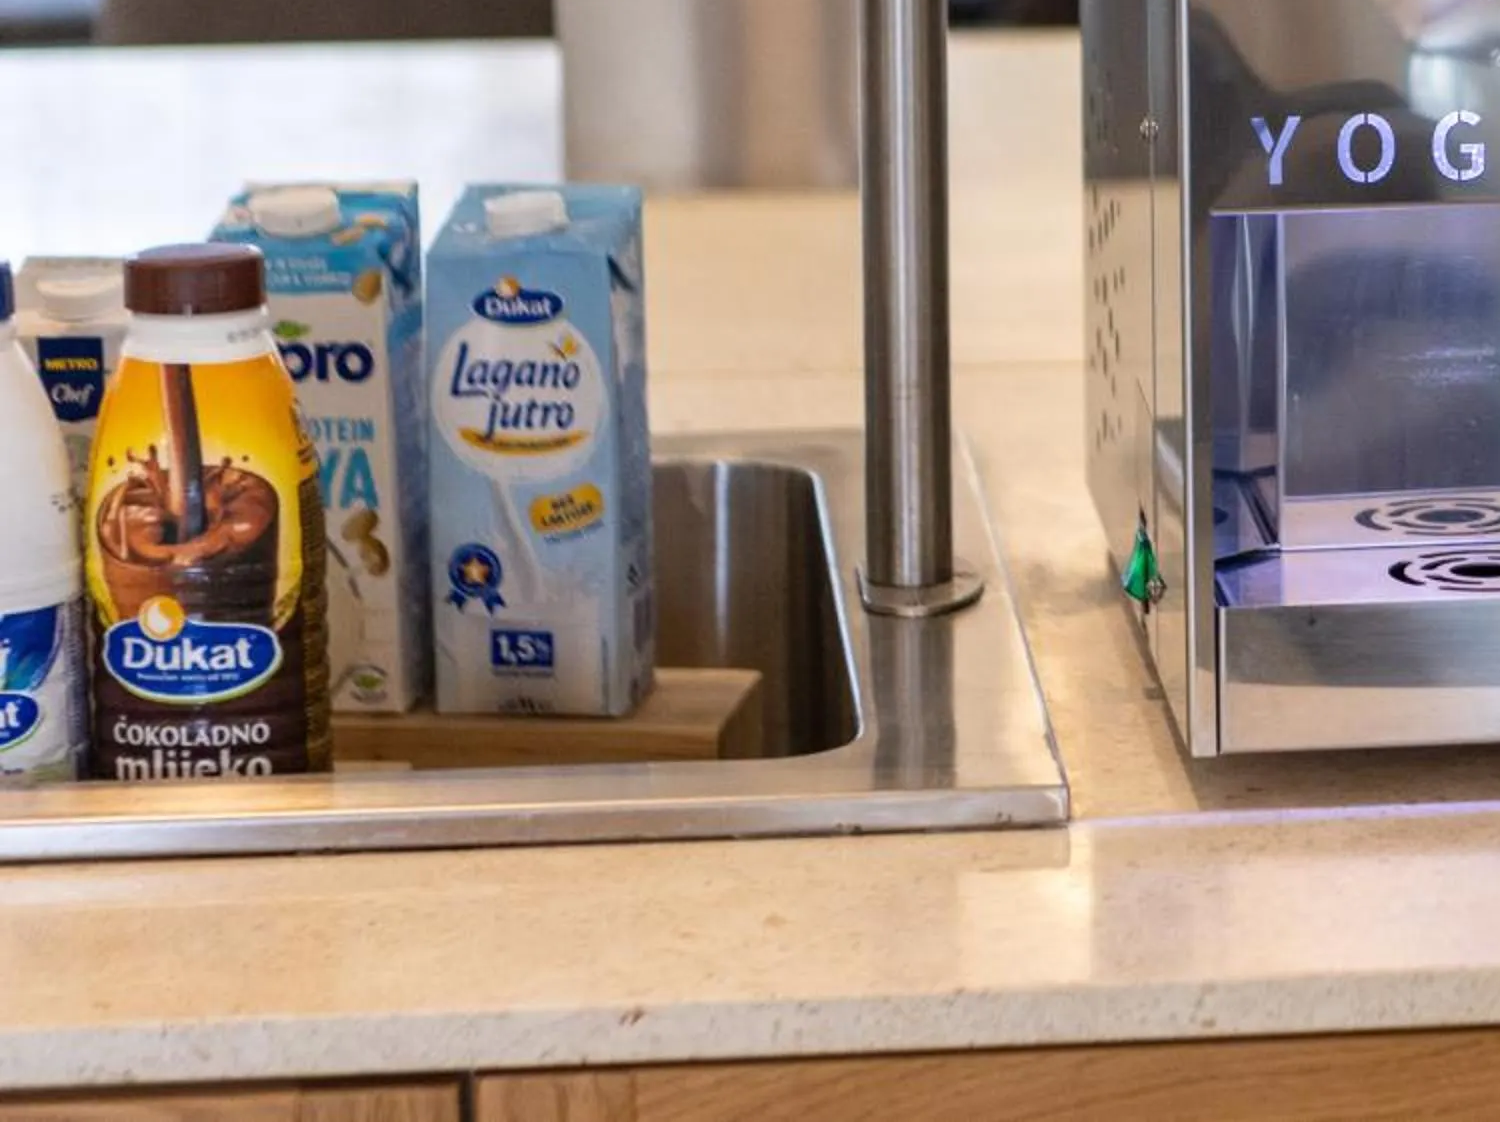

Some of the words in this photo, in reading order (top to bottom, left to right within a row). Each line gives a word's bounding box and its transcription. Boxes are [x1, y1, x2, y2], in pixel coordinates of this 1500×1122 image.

[484, 297, 551, 317] Dukat
[451, 341, 581, 397] Lagano
[484, 393, 575, 442] jutro
[123, 637, 254, 671] Dukat
[113, 715, 271, 747] ČOKOLADNO
